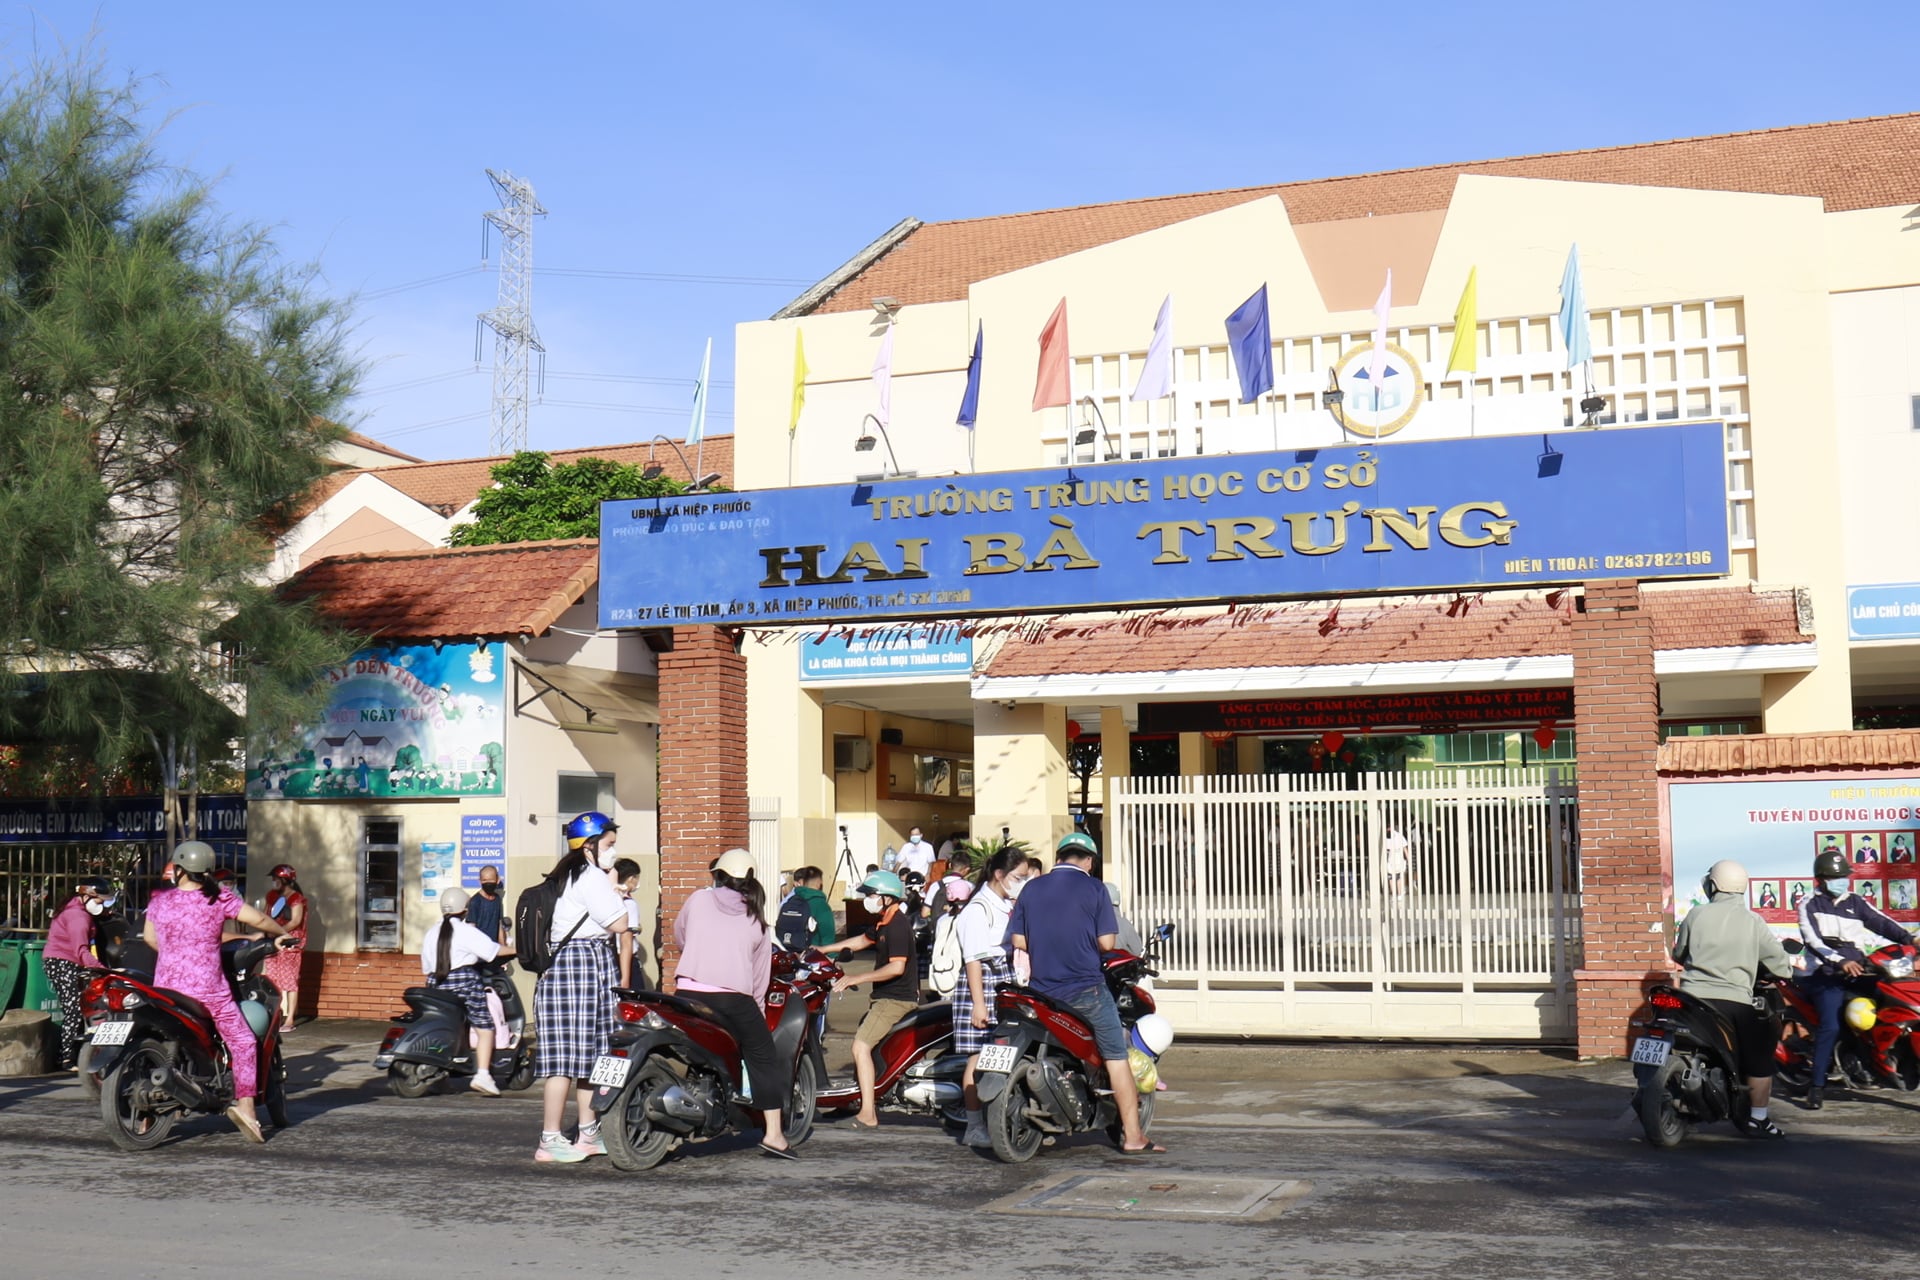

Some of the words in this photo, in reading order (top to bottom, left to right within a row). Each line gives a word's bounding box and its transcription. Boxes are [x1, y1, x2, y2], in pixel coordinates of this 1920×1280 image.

[867, 484, 1014, 520] TRƯỜNG
[1024, 478, 1149, 509] TRUNG
[1163, 470, 1243, 502] HỌC
[1257, 463, 1312, 494] CƠ
[1323, 451, 1379, 490] SỞ
[665, 505, 680, 517] XÃ
[683, 502, 709, 518] HIỆP
[713, 499, 752, 514] PHƯỚC
[759, 538, 930, 589] HAI
[963, 514, 1100, 576] BÀ
[1136, 501, 1518, 564] TRƯNG
[1504, 556, 1542, 575] ĐIỆN
[1549, 556, 1599, 573] THOẠI:
[1604, 551, 1711, 569] 02837822196
[638, 607, 653, 620] 27
[656, 603, 670, 619] LÊ
[764, 598, 780, 614] XÃ
[785, 595, 813, 614] HIỆP
[1853, 603, 1876, 618] LÀM
[1879, 601, 1900, 618] CHỦ
[355, 654, 390, 674] ĐẾN
[808, 658, 820, 669] LÀ
[822, 656, 842, 669] CHÌA
[870, 653, 889, 666] CỦA
[890, 655, 908, 668] MỌI
[910, 652, 940, 665] THÀNH
[941, 651, 967, 664] CÔNG
[1546, 691, 1568, 701] EM
[360, 705, 397, 723] NGÀY
[400, 708, 424, 721] VUI
[46, 812, 65, 833] EM
[69, 812, 104, 833] XANH
[117, 810, 151, 836] SẠCH
[1748, 808, 1804, 823] TUYÊN
[1808, 807, 1869, 822] DƯƠNG
[1874, 807, 1911, 823] HỌC
[465, 849, 479, 857] VUI
[480, 847, 501, 857] LÒNG
[985, 1046, 1012, 1059] 59-Z1
[599, 1057, 625, 1072] 59-Z1
